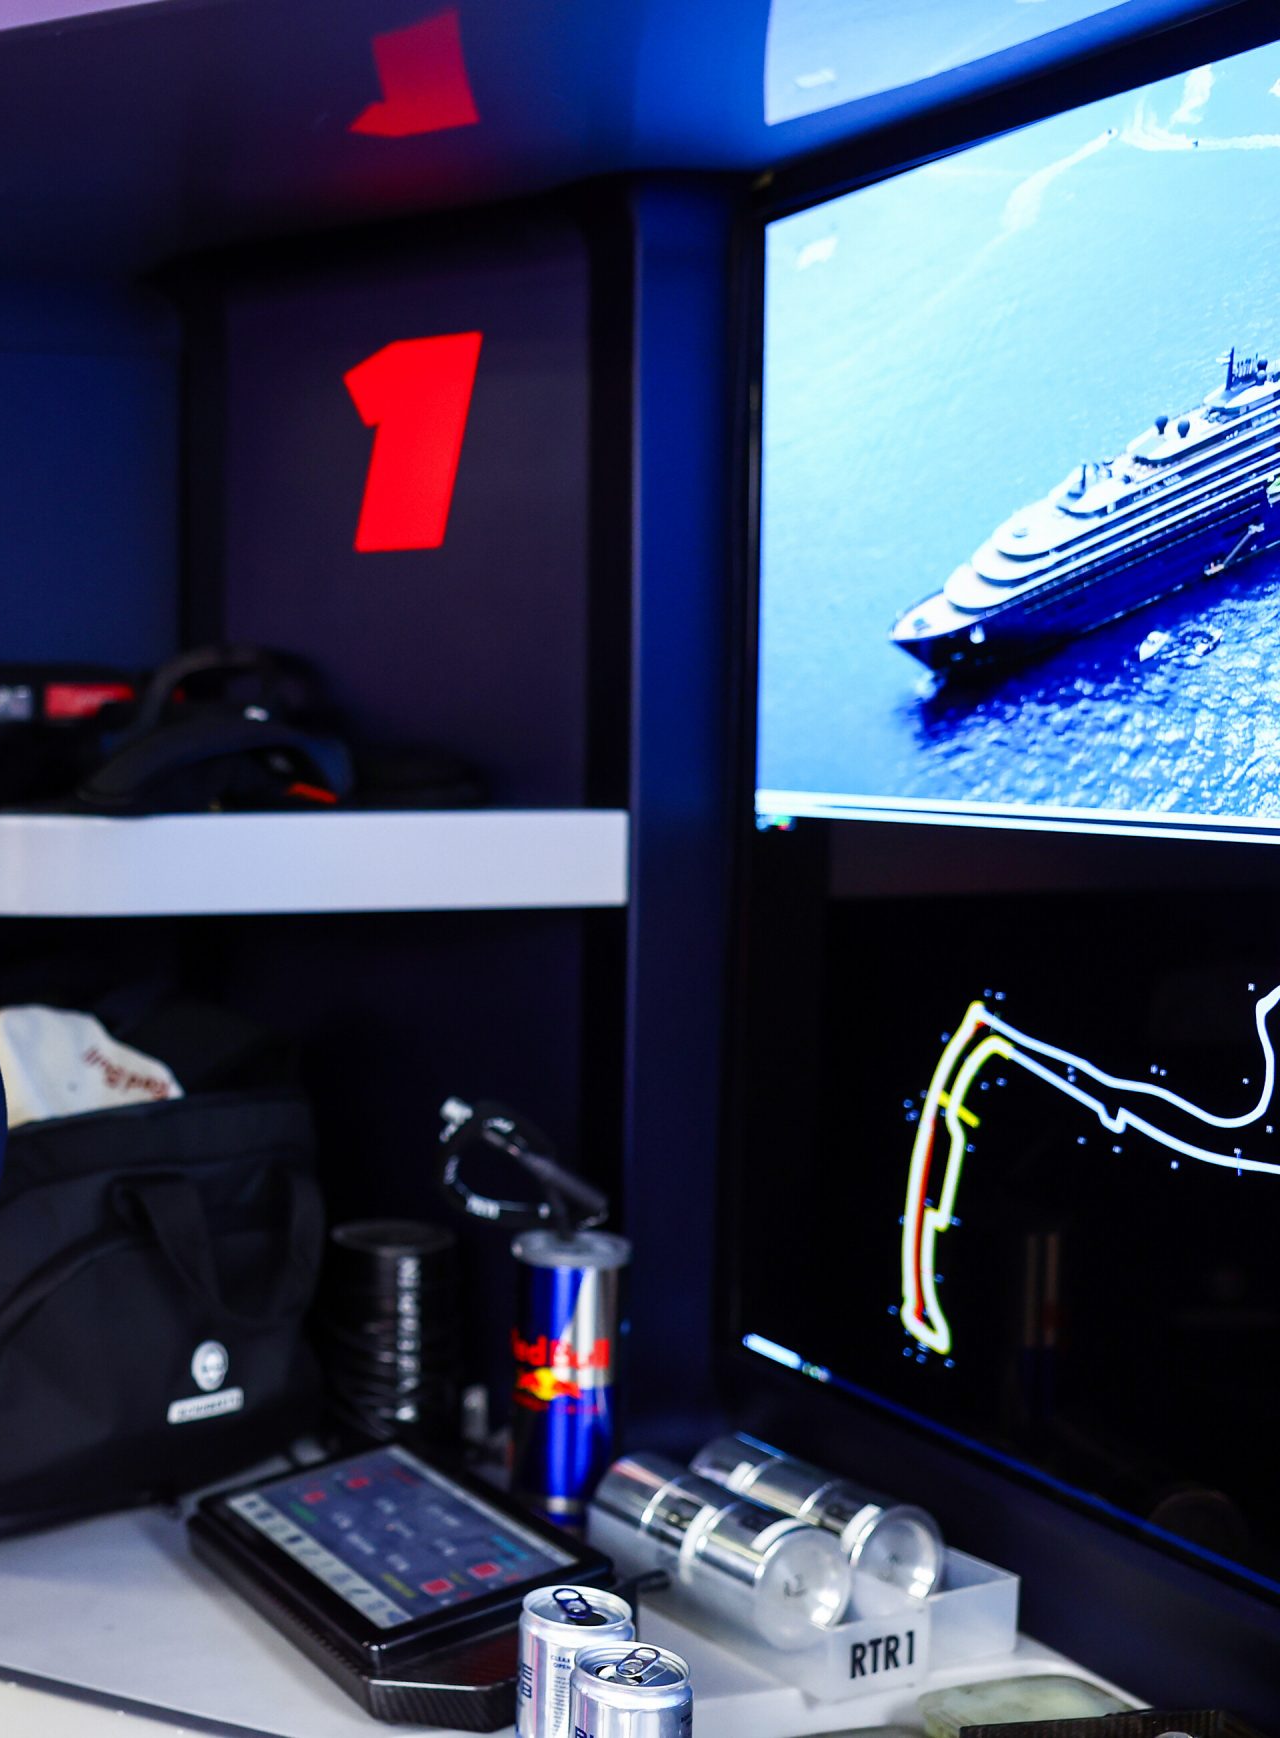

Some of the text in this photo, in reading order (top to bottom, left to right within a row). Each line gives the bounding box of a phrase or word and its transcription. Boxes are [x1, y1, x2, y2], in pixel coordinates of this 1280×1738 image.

[342, 331, 483, 553] 1
[849, 1629, 916, 1680] RTR 1
